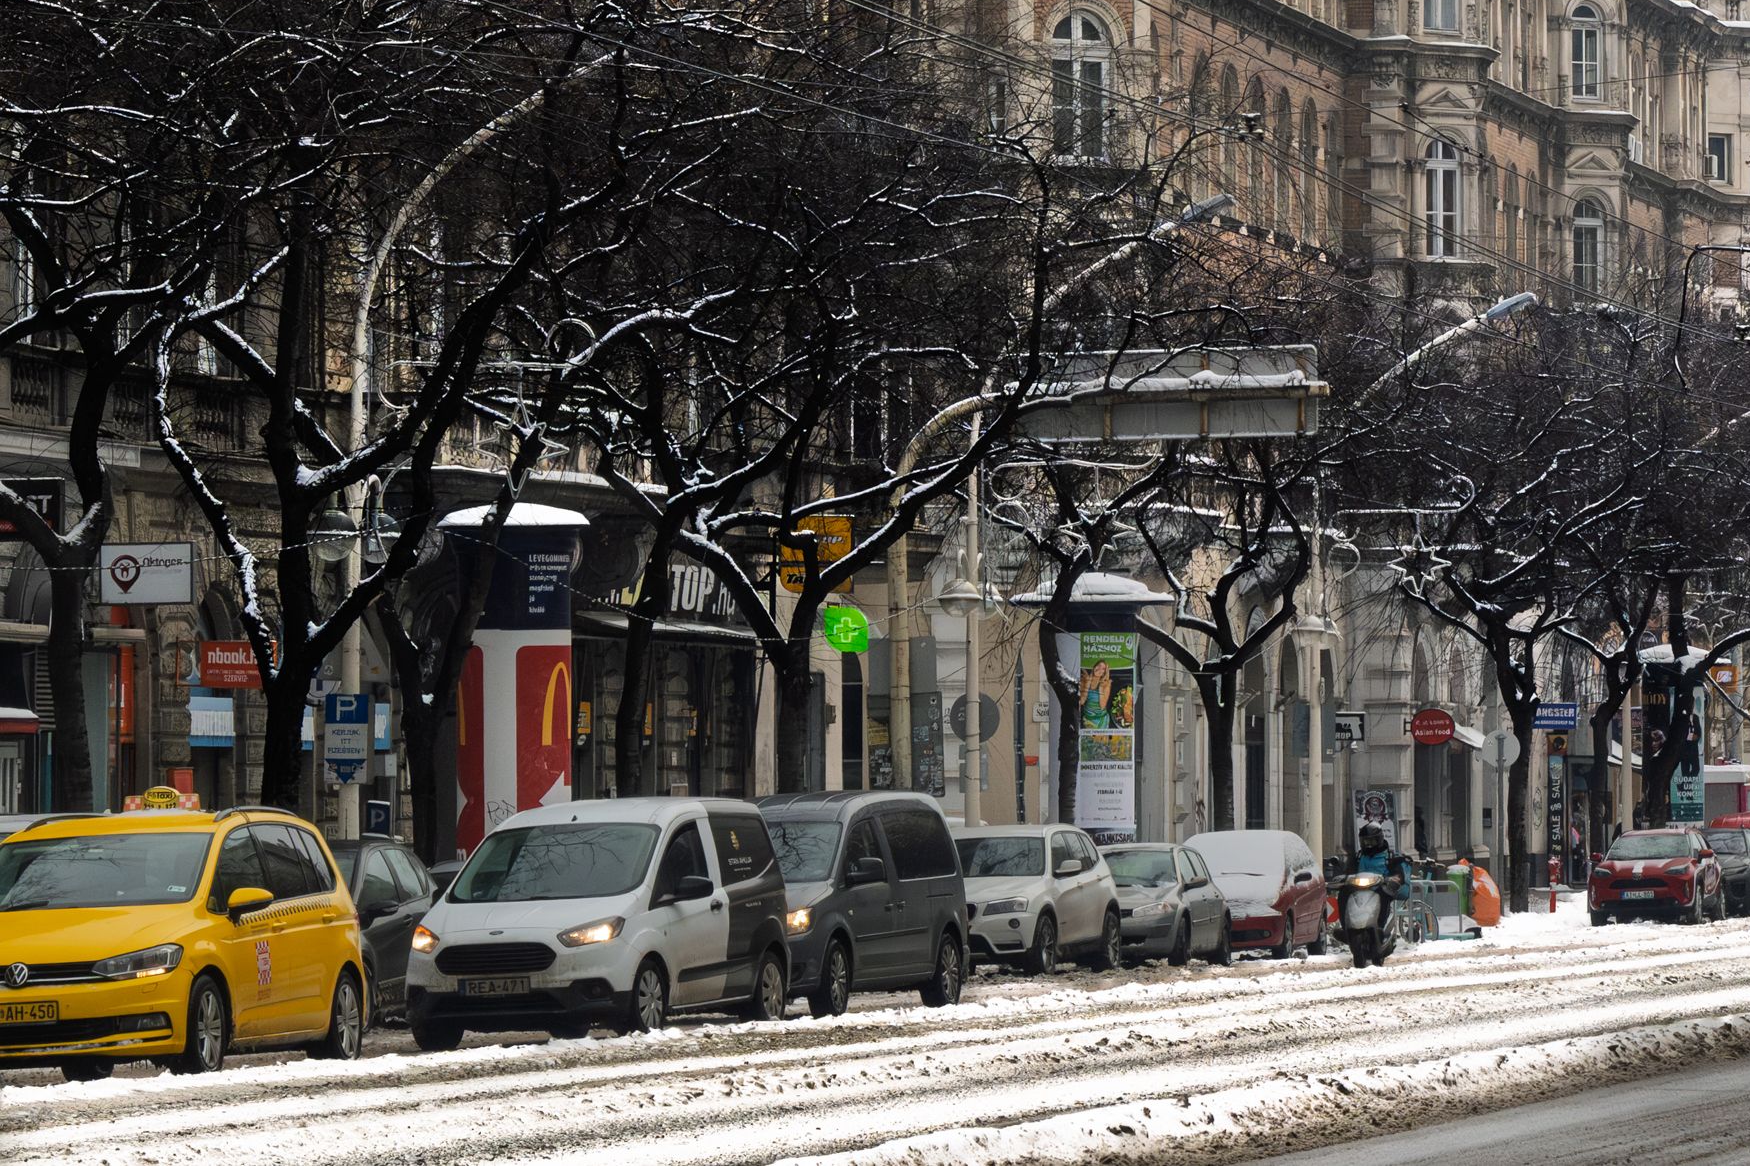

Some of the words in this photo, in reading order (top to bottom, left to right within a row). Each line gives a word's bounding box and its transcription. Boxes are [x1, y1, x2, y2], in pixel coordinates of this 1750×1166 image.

[207, 647, 257, 665] nbook.h
[1535, 707, 1575, 718] ANGSTER
[1551, 775, 1562, 799] SALE
[1551, 815, 1562, 841] SALE
